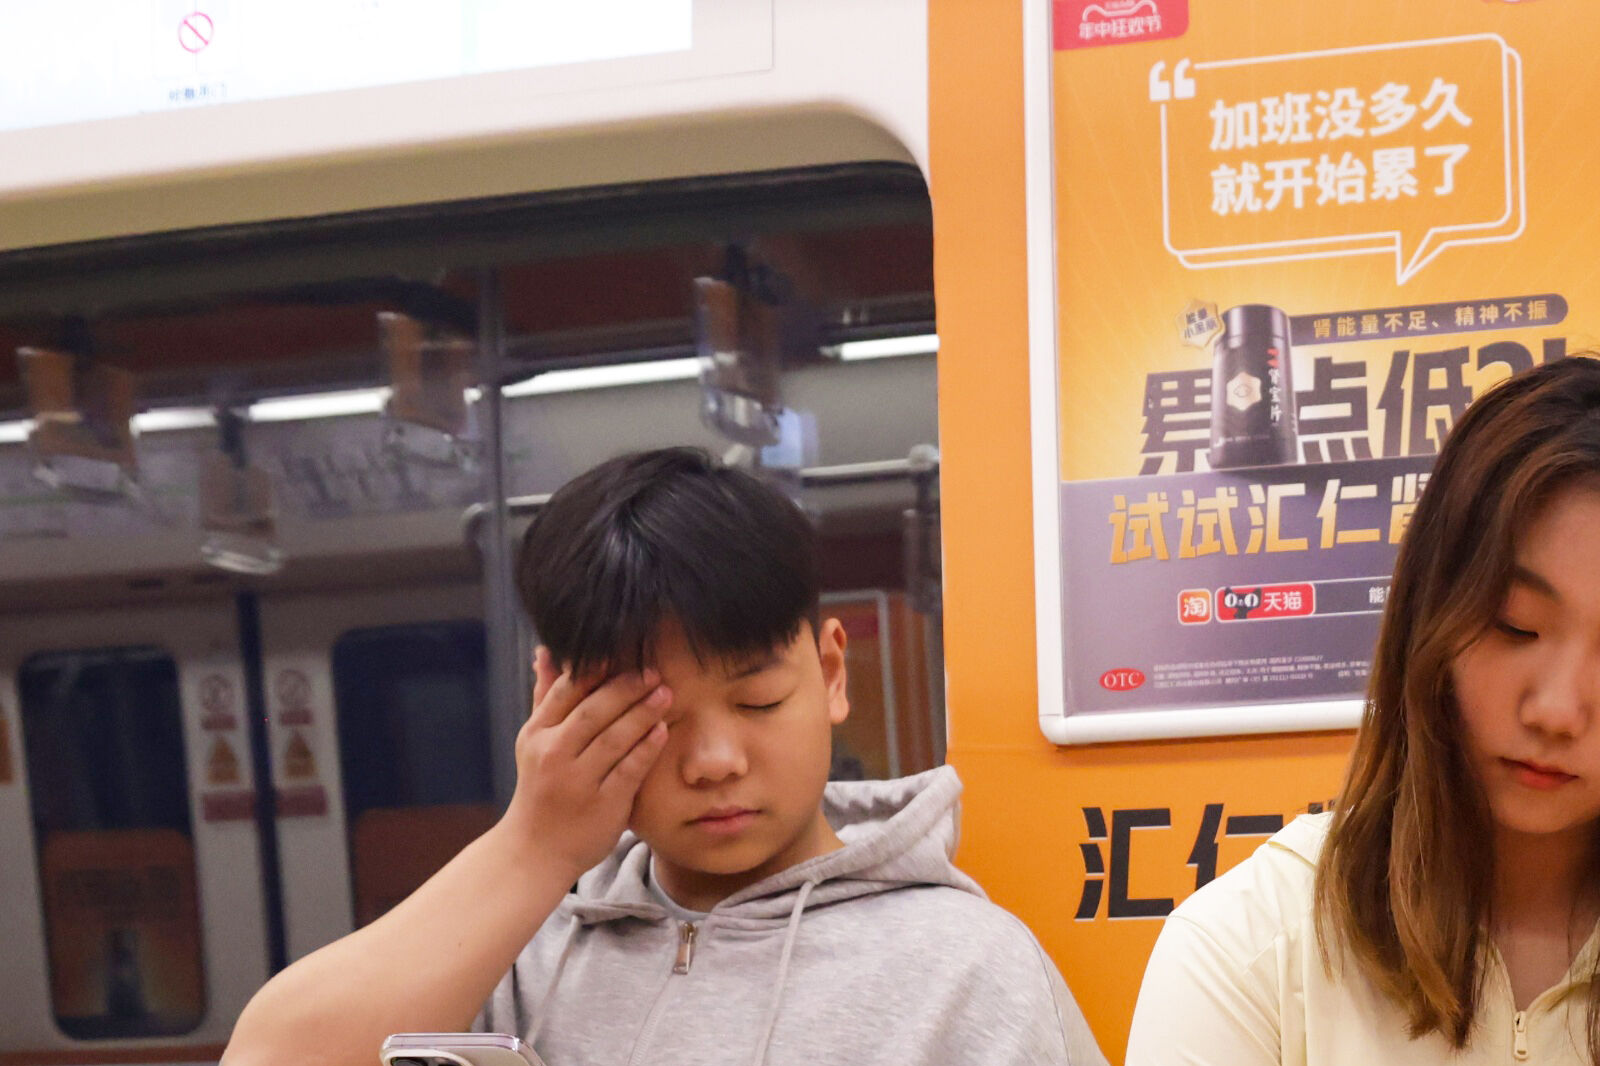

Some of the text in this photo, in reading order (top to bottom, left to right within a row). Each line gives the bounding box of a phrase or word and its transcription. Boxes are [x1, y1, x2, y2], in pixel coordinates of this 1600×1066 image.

[1209, 77, 1472, 151] 加班没多久
[1210, 143, 1470, 216] 就开始累了
[1313, 300, 1548, 339] 肾能量不足、精神不振
[1139, 338, 1567, 476] 累点低
[1184, 586, 1391, 617] 淘 天猫 能
[1103, 671, 1140, 689] OTC
[1074, 800, 1335, 922] 汇仁
